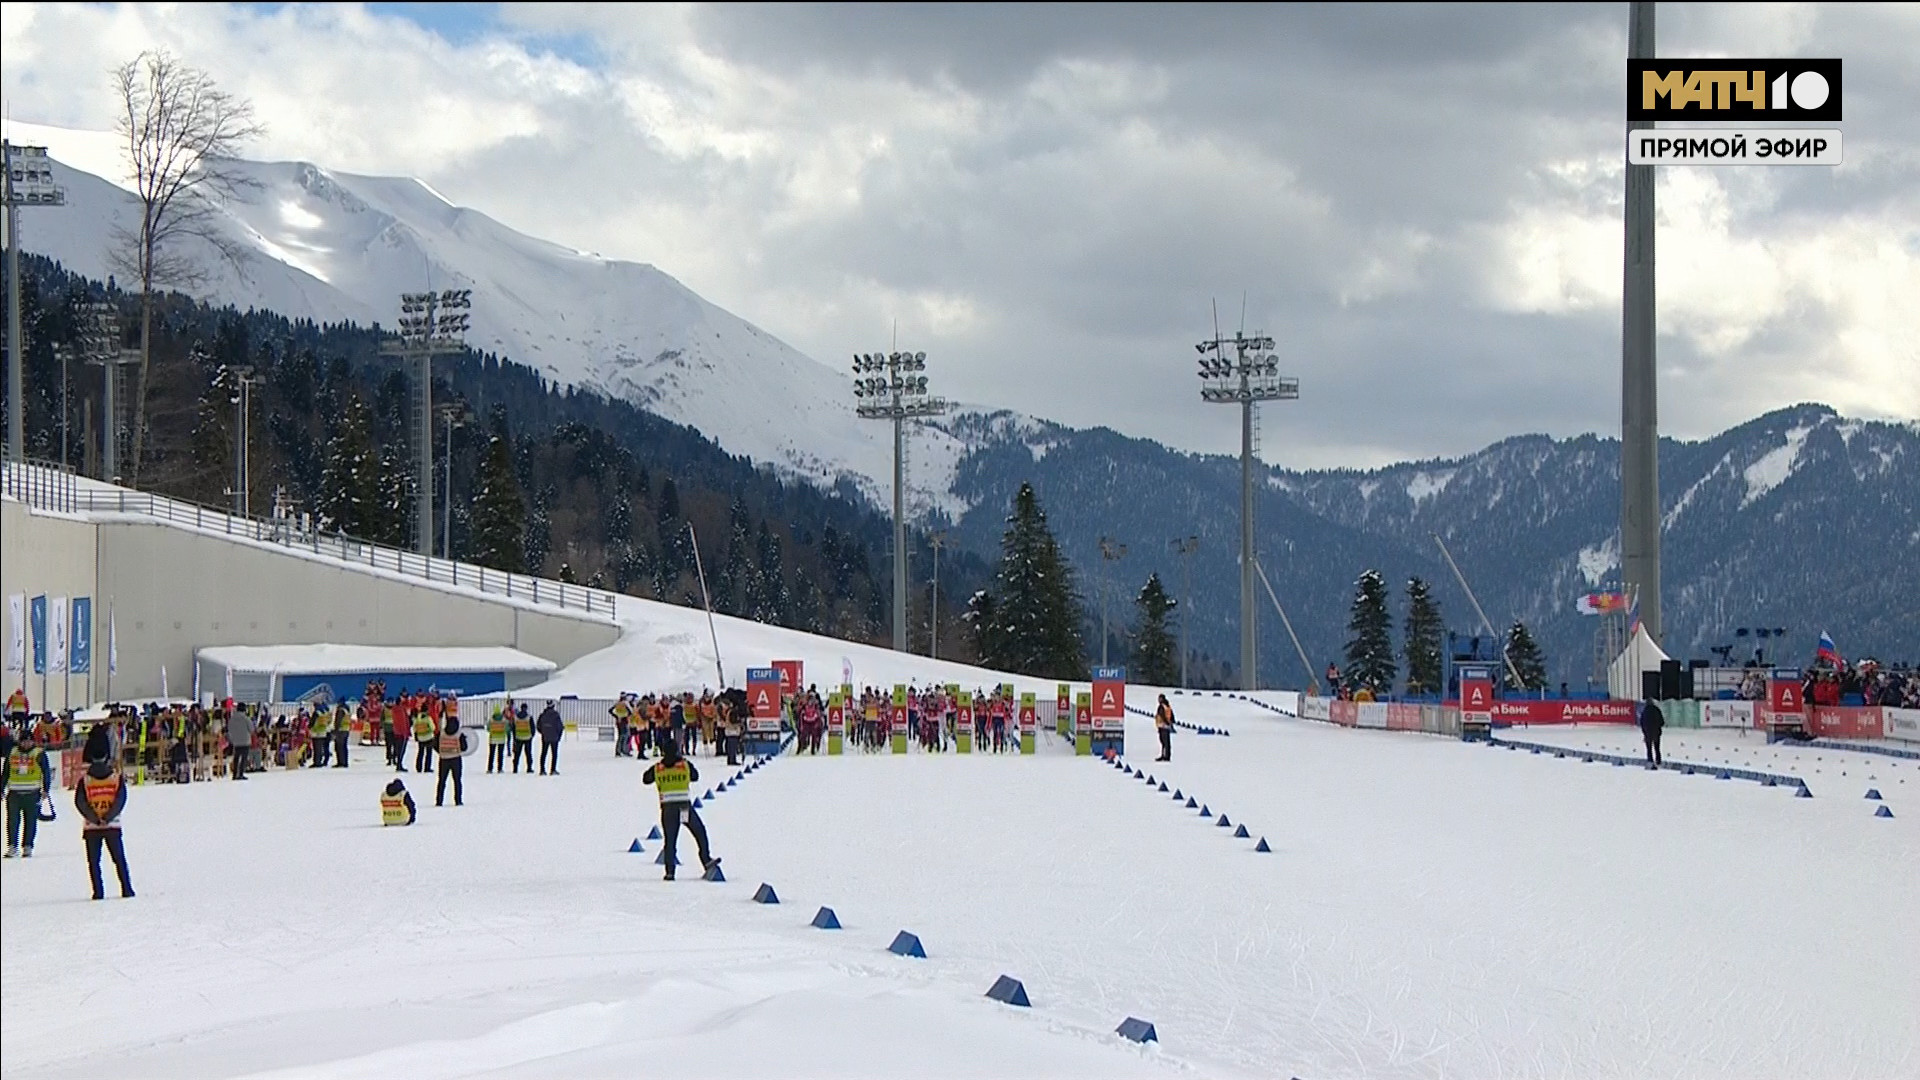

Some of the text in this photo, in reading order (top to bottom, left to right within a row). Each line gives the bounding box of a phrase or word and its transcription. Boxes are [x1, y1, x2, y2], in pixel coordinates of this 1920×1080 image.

[753, 670, 772, 678] СТАРТ
[1099, 669, 1119, 678] СТАРТ
[1501, 704, 1529, 714] Банк
[1563, 704, 1631, 717] Альфа Банк
